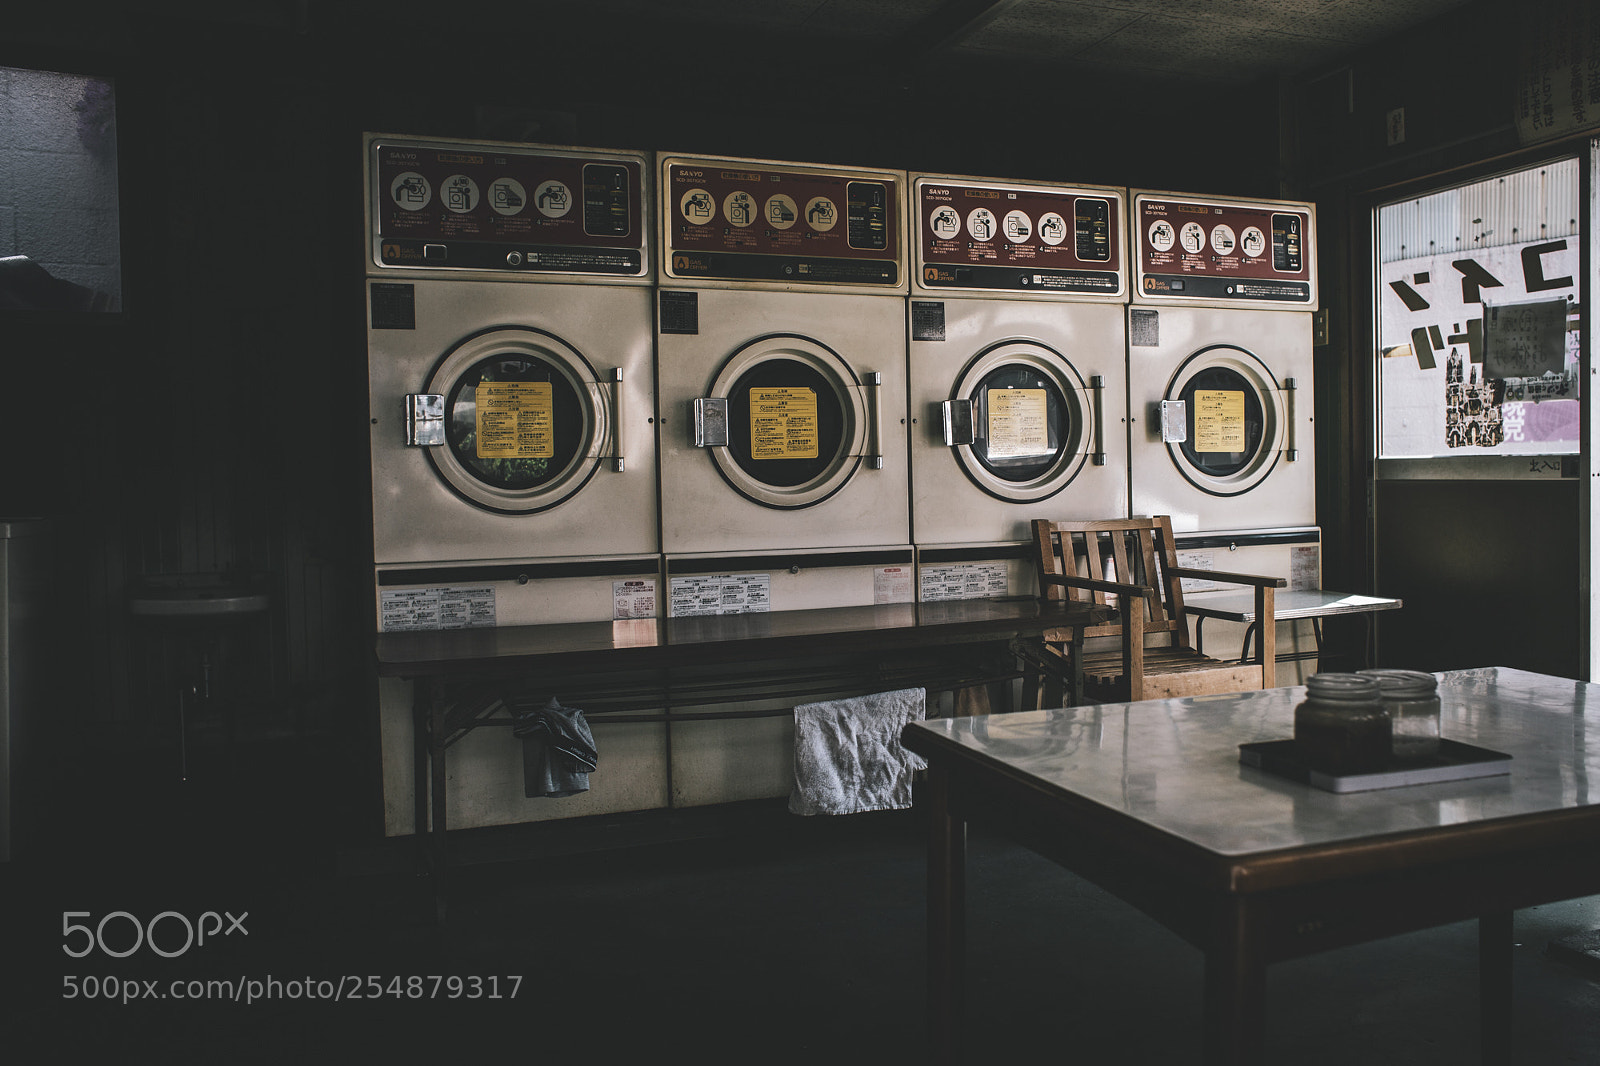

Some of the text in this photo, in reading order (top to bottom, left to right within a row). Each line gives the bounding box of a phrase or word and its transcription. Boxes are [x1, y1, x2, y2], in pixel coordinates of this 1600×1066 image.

[390, 152, 417, 161] SANYO
[679, 169, 704, 178] SANYO
[928, 188, 951, 196] SANYO
[1530, 459, 1561, 473] 出入口
